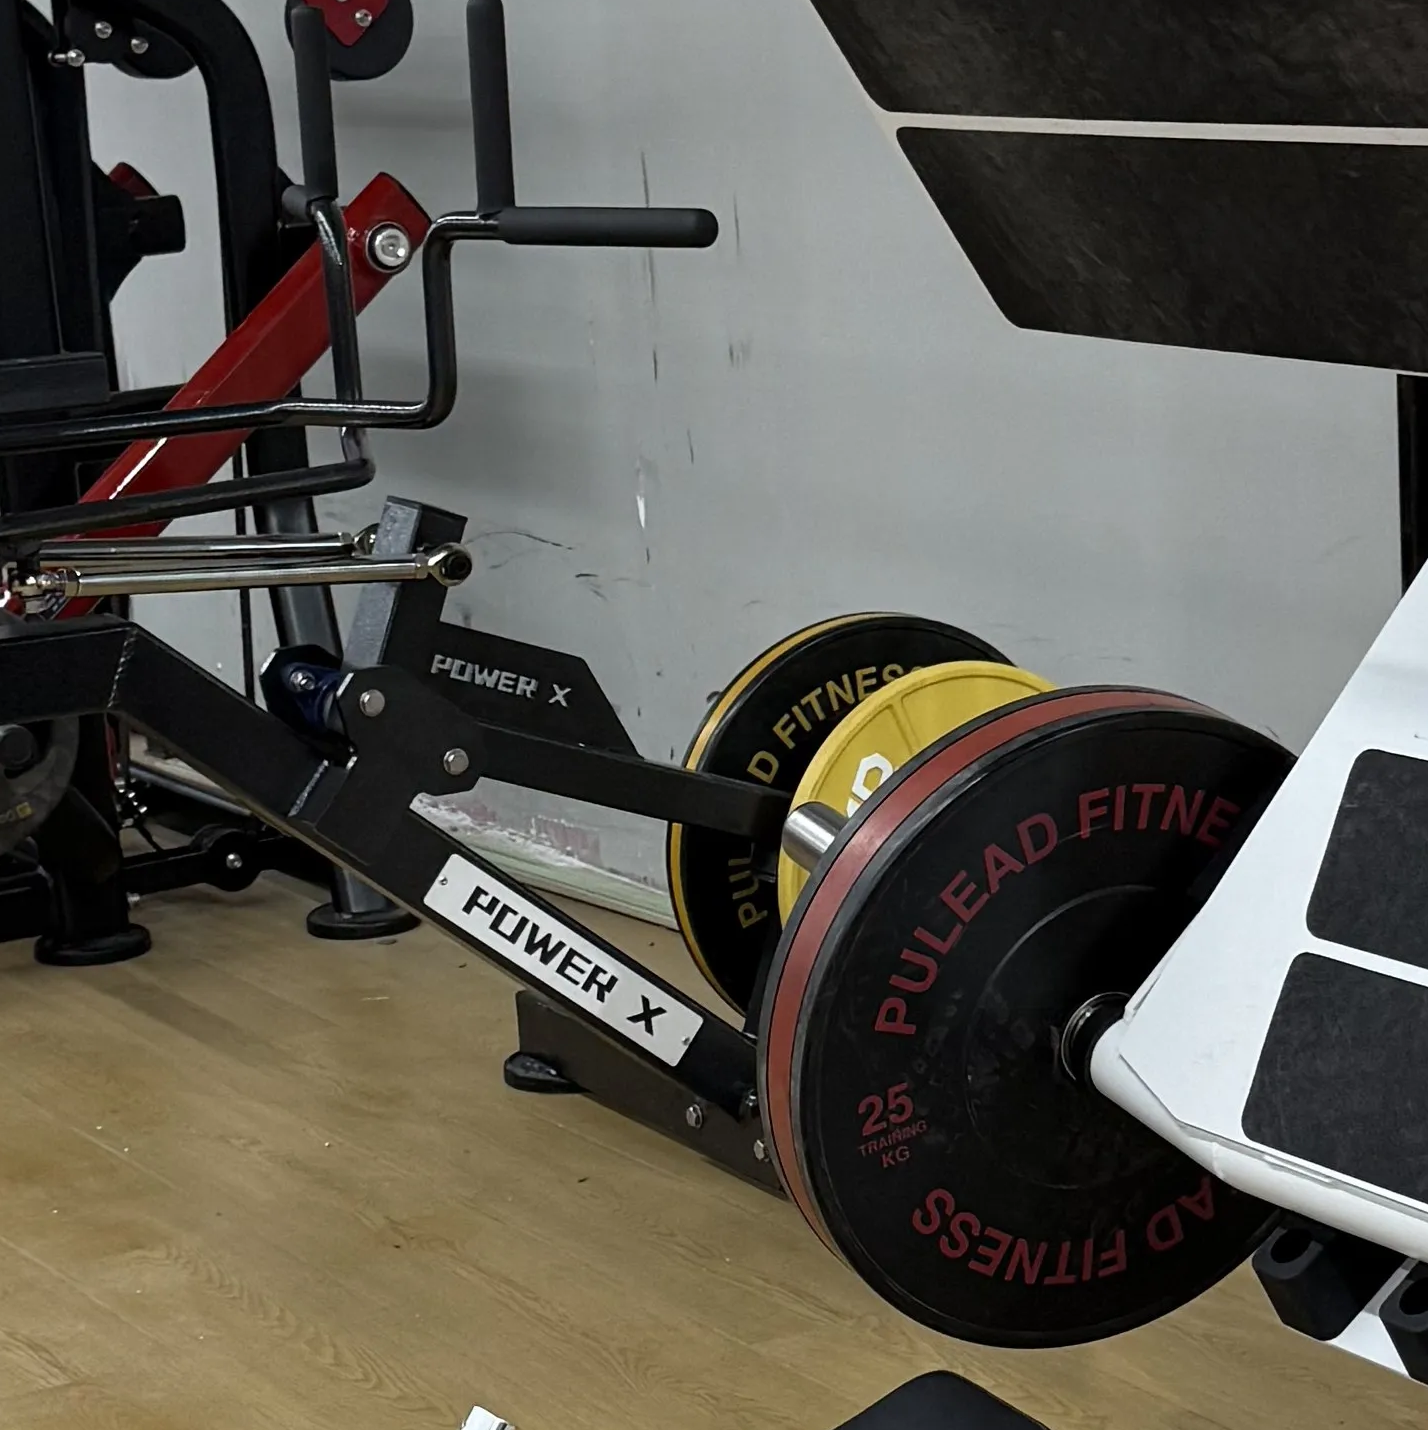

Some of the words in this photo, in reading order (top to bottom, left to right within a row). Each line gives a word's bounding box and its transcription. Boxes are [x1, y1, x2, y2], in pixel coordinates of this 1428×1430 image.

[430, 654, 539, 700] POWER
[548, 683, 572, 708] X
[875, 812, 1059, 1036] PULEAD
[1078, 782, 1241, 847] FITNE
[462, 885, 619, 1003] POWER
[626, 994, 667, 1037] X
[857, 1082, 914, 1137] 25
[858, 1119, 928, 1157] TRAINING
[880, 1145, 911, 1168] KG
[911, 1188, 1128, 1286] FITNESS
